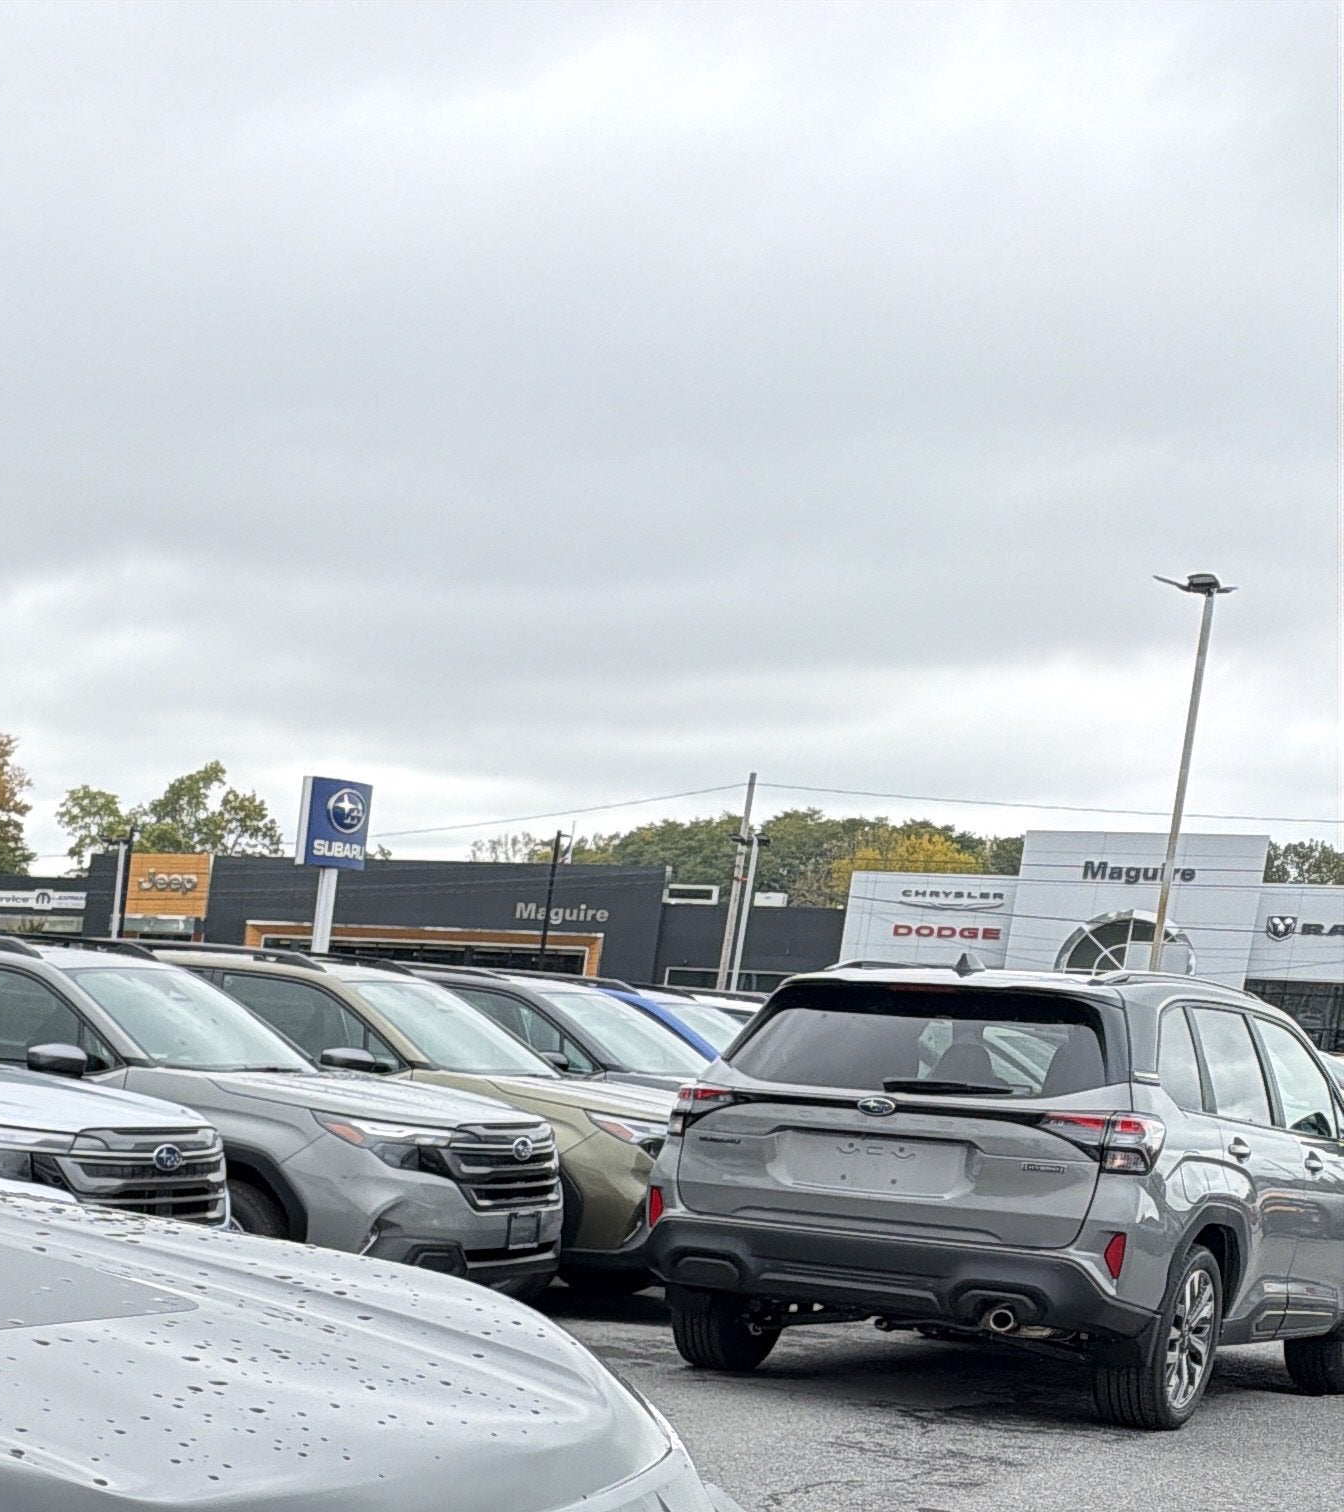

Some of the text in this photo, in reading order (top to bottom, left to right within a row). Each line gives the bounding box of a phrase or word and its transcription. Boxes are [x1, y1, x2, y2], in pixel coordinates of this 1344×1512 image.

[313, 839, 365, 861] SUBARU
[137, 868, 198, 895] Jeep
[901, 889, 1005, 900] CHRYSLER
[515, 902, 610, 925] Maguire
[892, 924, 1002, 940] DODGE
